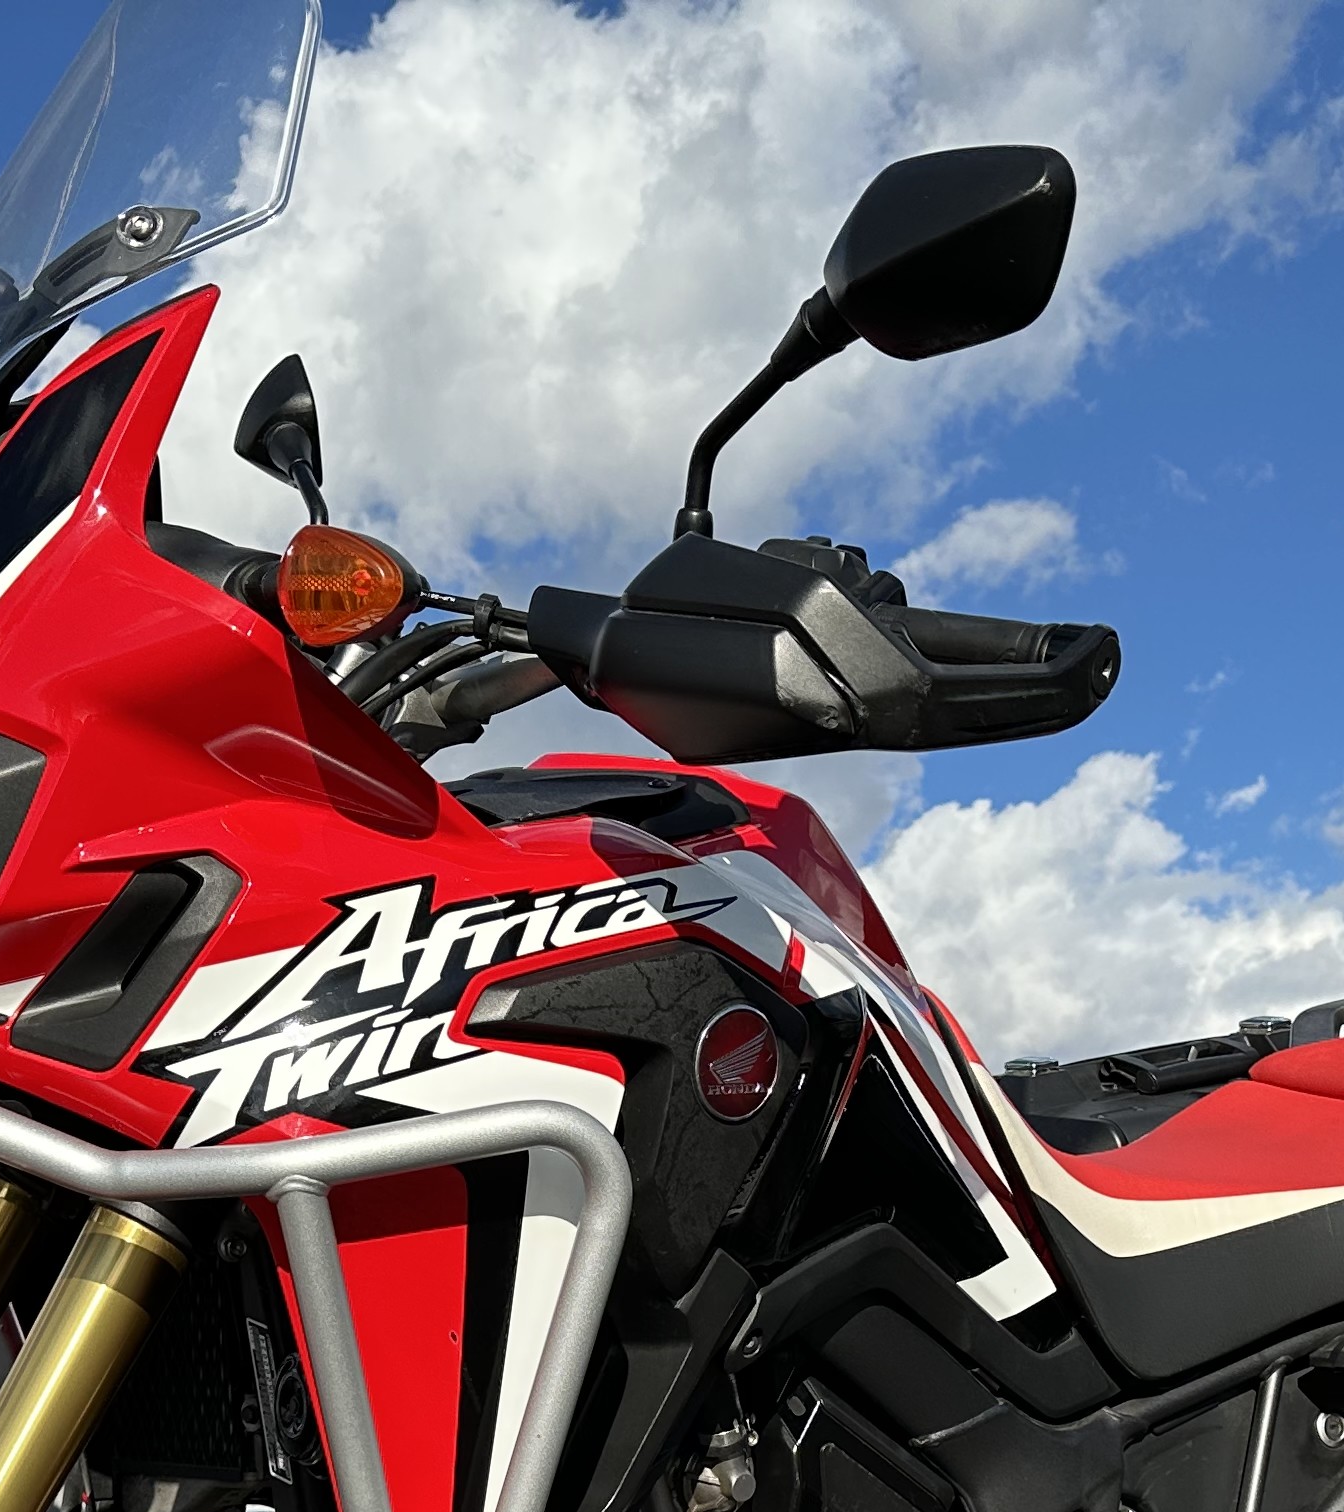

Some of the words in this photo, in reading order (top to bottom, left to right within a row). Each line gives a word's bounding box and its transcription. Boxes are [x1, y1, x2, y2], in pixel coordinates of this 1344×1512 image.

[224, 880, 672, 1042] Africa
[164, 1000, 482, 1152] Twin
[706, 1082, 767, 1096] HONDA
